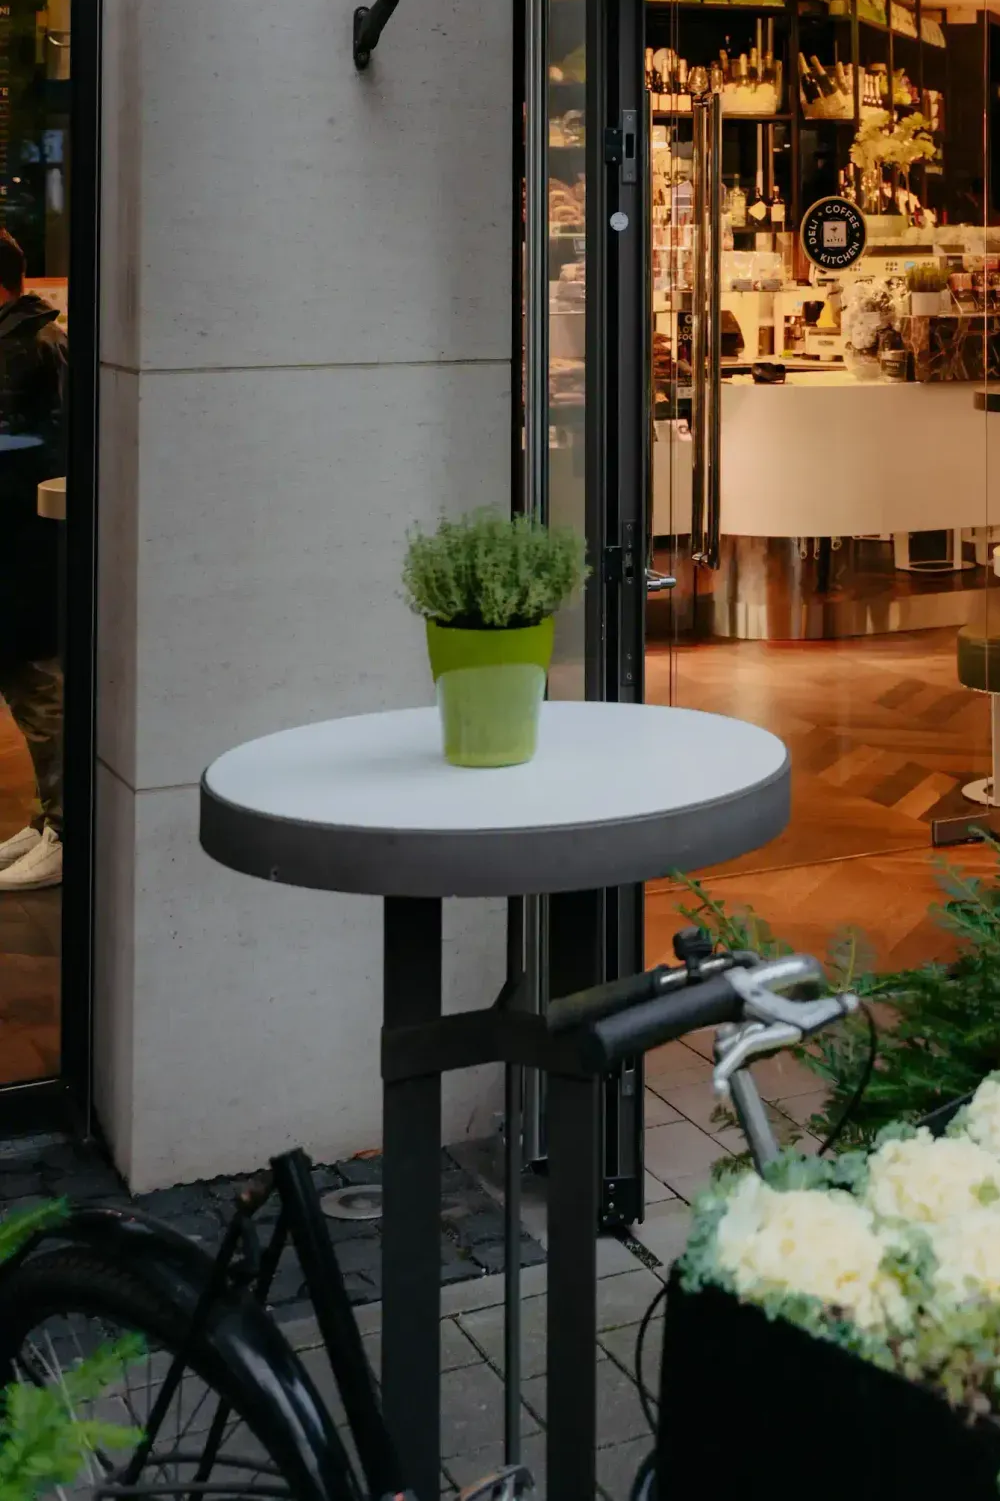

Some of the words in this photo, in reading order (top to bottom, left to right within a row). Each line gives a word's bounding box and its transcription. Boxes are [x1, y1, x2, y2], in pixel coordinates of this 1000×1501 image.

[825, 204, 860, 229] COFFEE
[808, 219, 819, 245] DELI
[820, 241, 860, 265] KITCHEN
